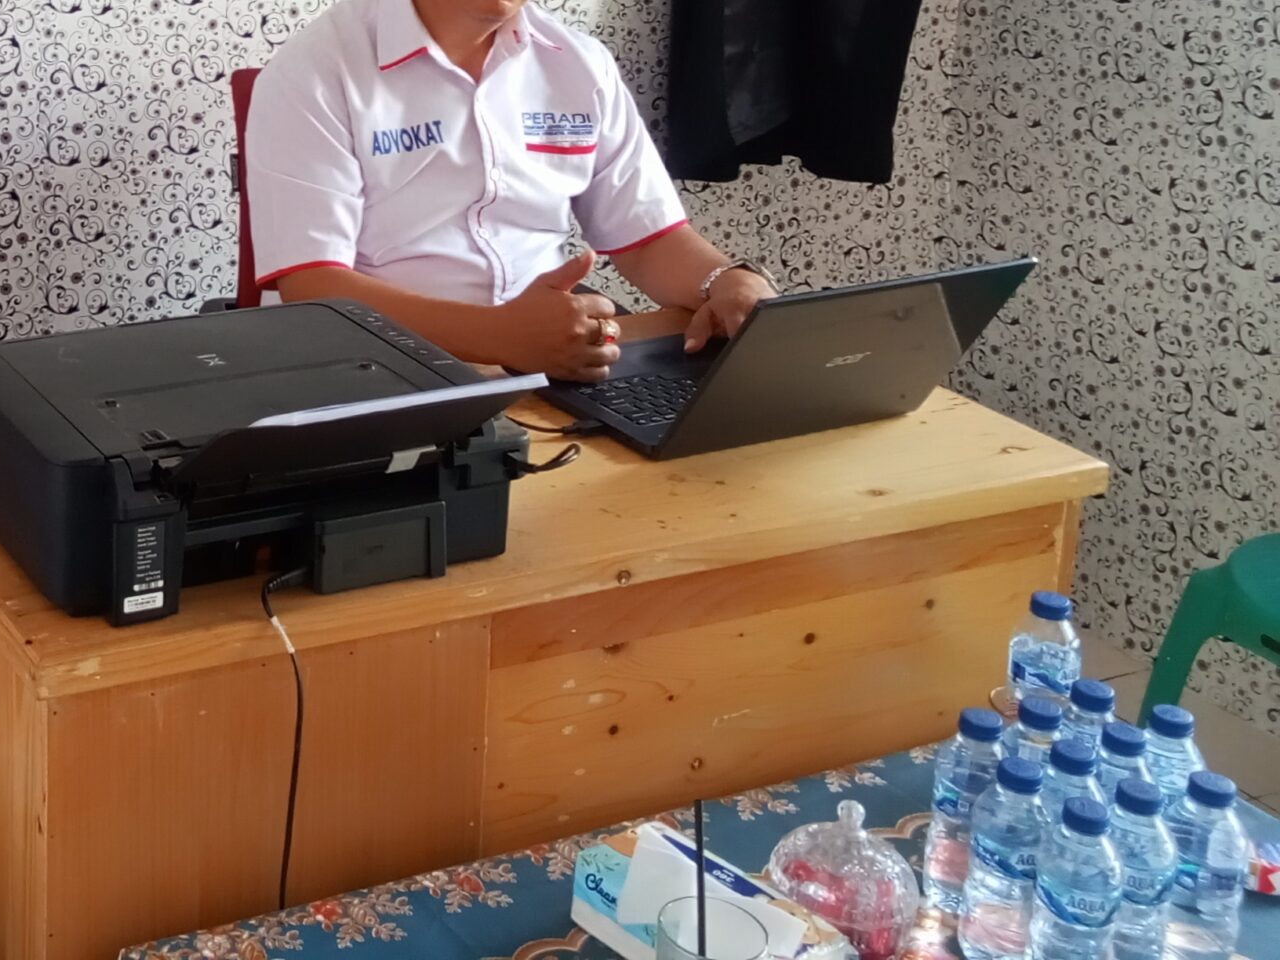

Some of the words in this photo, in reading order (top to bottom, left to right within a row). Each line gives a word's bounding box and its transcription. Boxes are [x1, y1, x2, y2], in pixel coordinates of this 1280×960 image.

[521, 112, 592, 124] PERADI
[372, 120, 444, 156] ADVOKAT
[1065, 895, 1106, 913] AQUA
